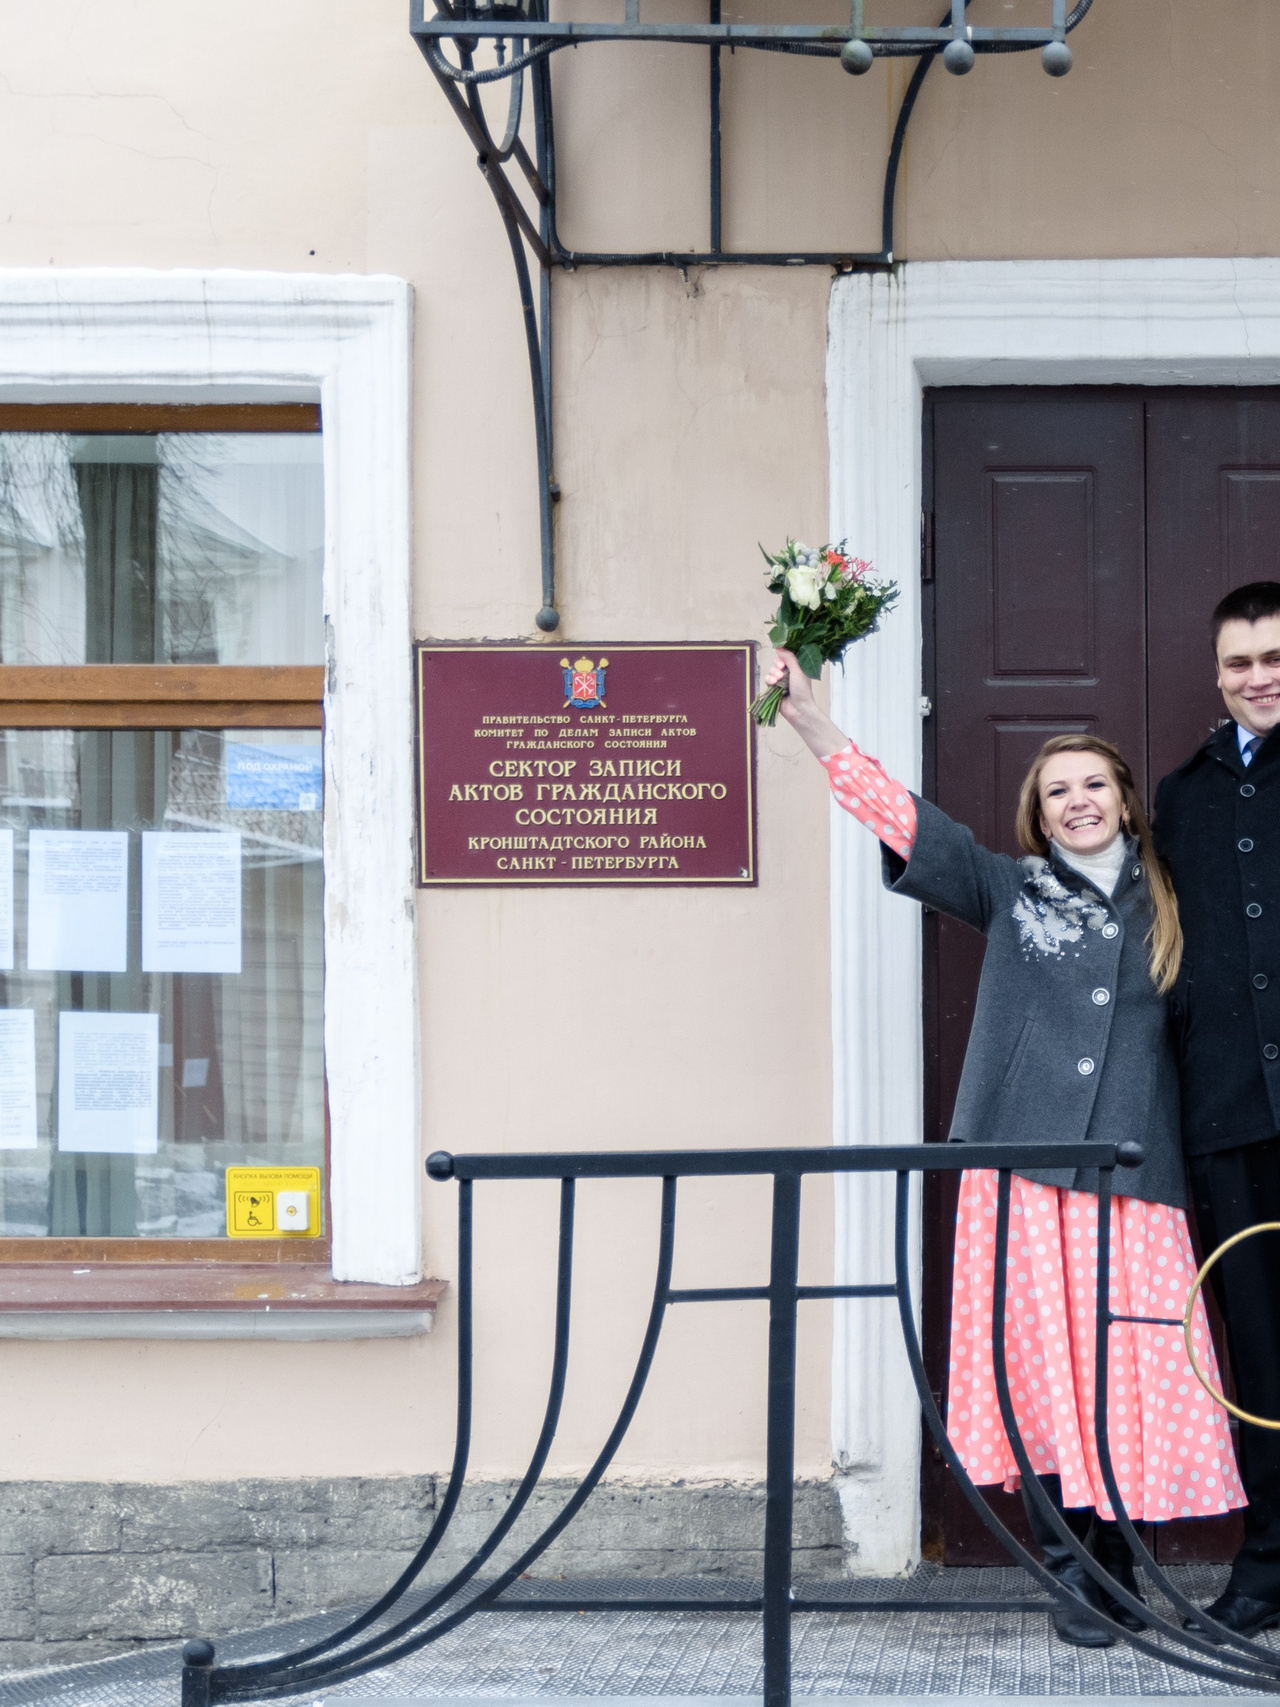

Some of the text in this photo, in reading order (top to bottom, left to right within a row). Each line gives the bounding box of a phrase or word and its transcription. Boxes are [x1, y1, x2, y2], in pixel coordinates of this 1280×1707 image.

[482, 716, 570, 725] ПРАВИТЕЛЬСТВО
[474, 728, 696, 738] КОМИТЕТ ПО ДЕЛАМ ЗАПИСИ АКТОВ
[506, 741, 666, 750] ГРАЖДАНСКОГО СОСТОЯНИЯ
[237, 760, 313, 771] ПОД ОХРАНОЙ
[488, 760, 681, 777] СЕКТОР ЗАПИСИ
[448, 784, 726, 803] АКТОВ ГРАЖДАНСКОГО
[515, 809, 657, 825] СОСТОЯНИЯ
[468, 834, 706, 851] КРОНШТАДТСКОГО РАЙОНА
